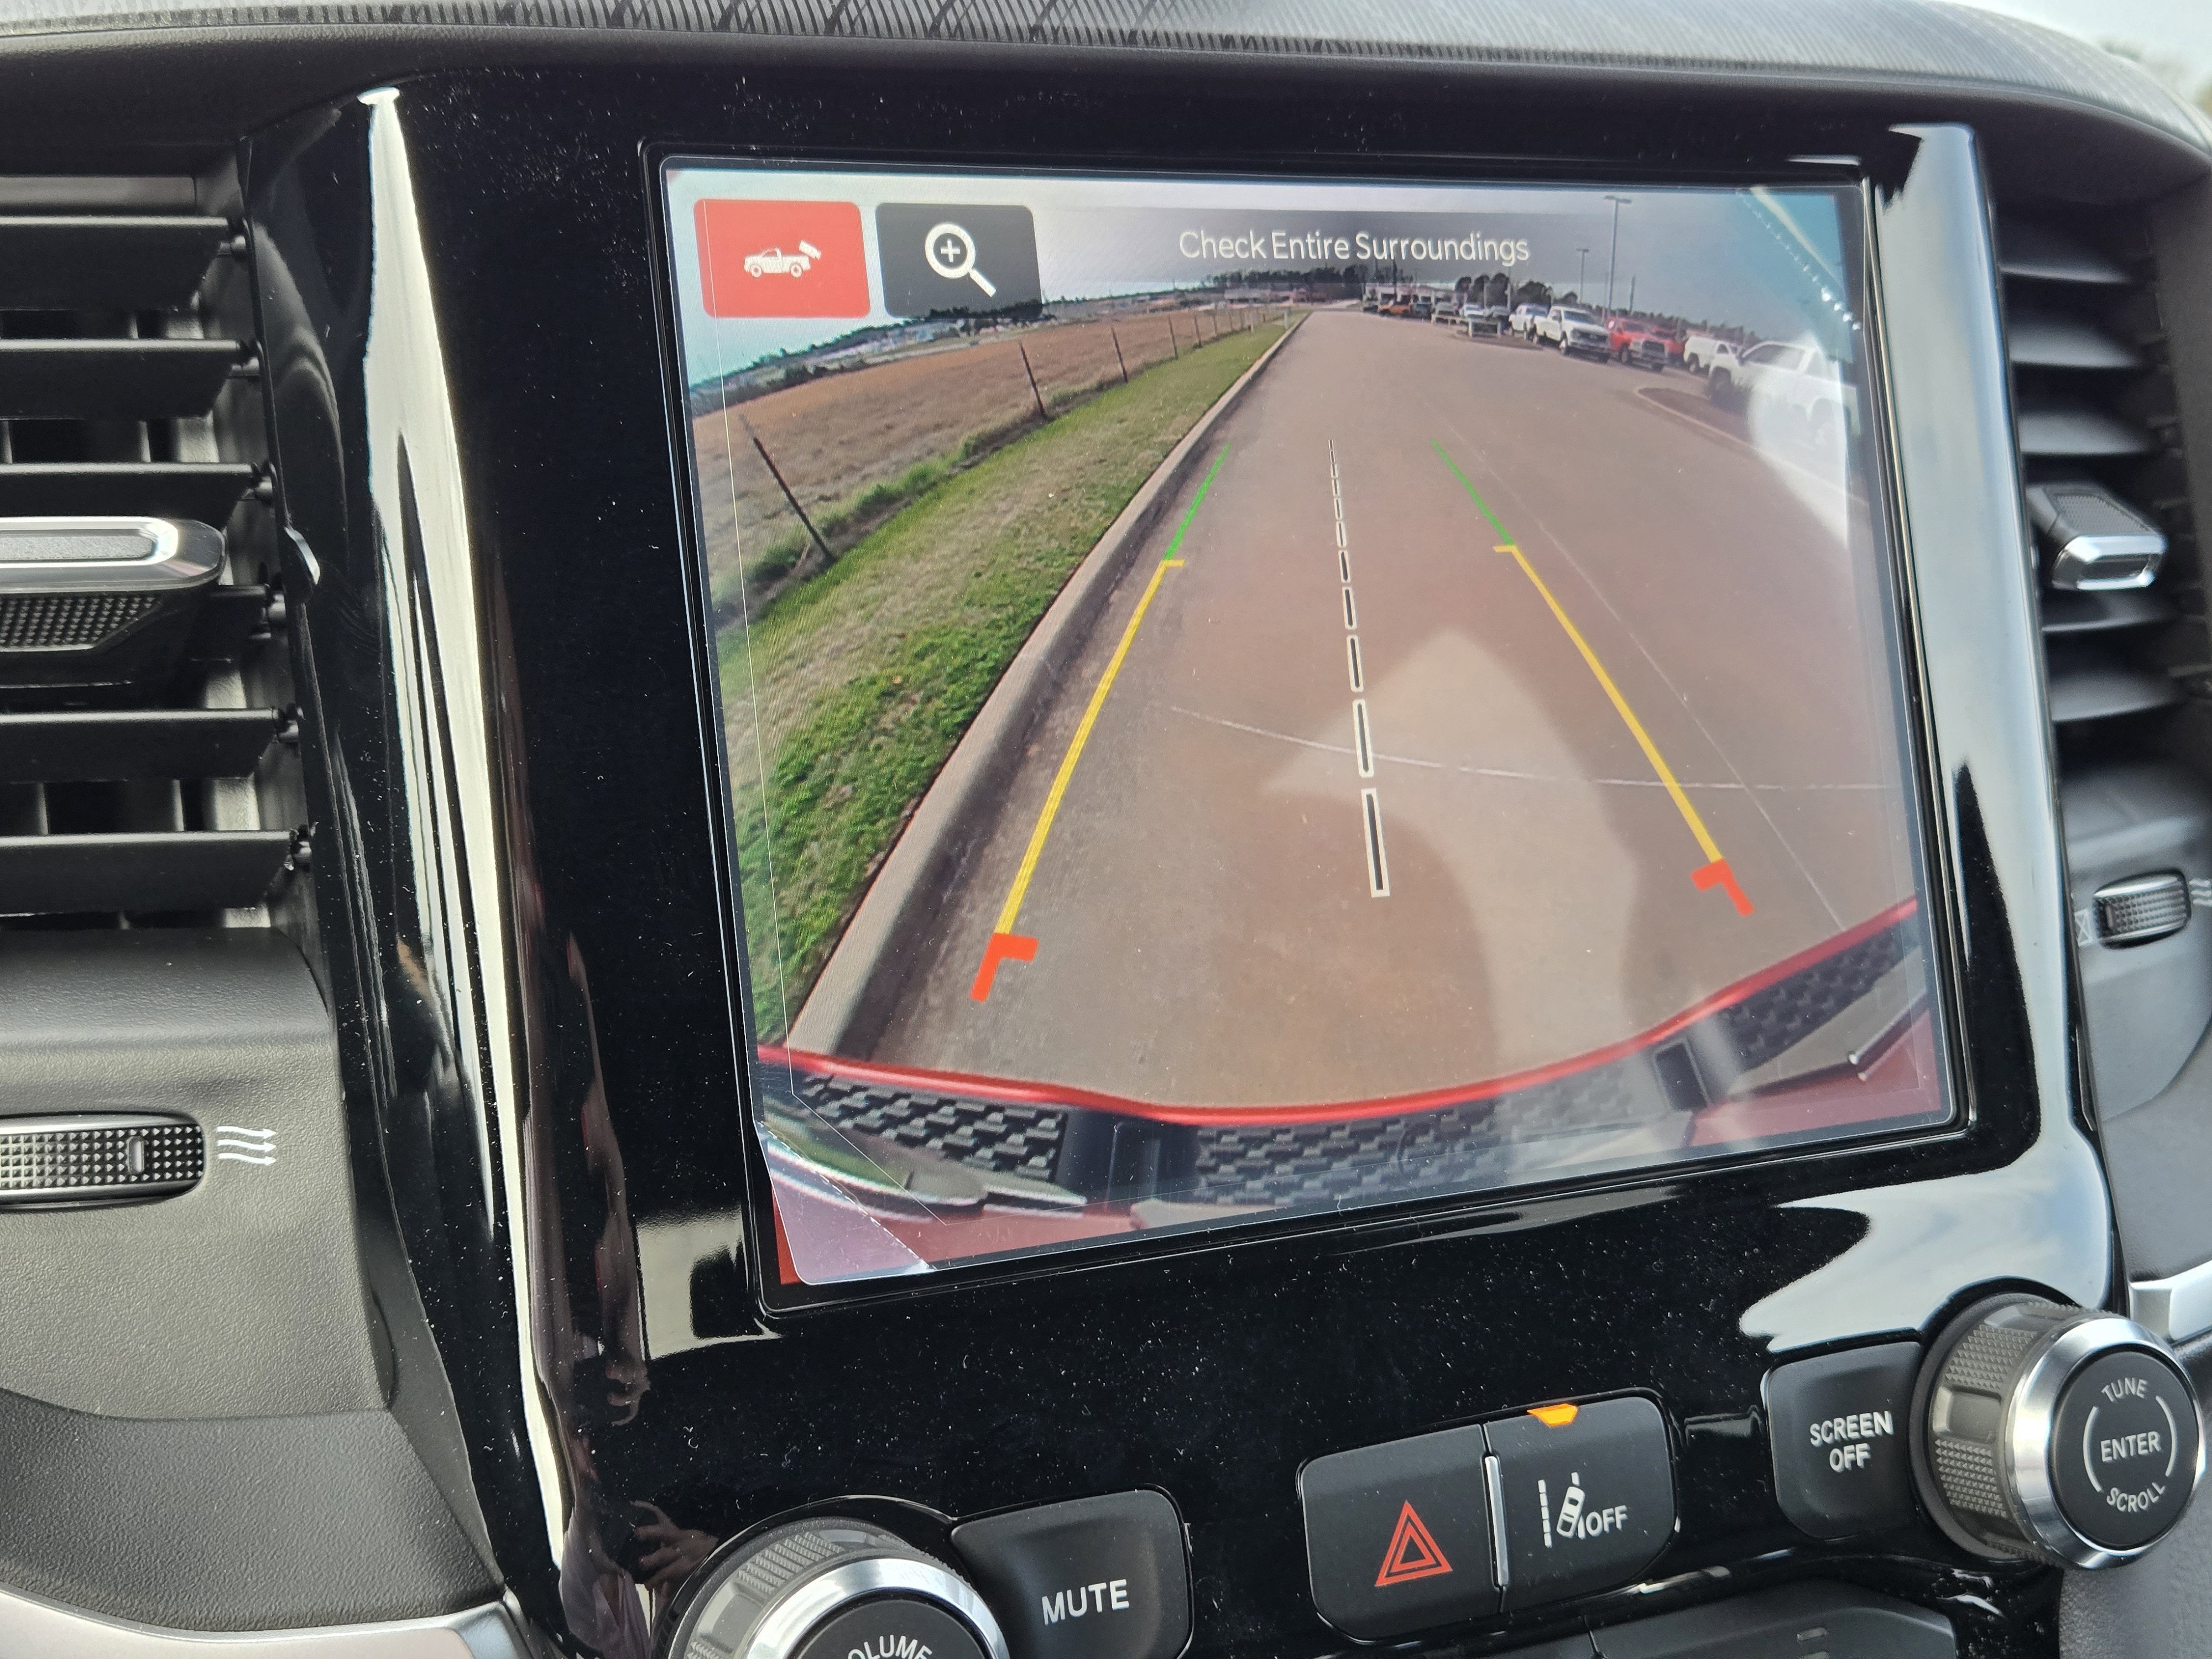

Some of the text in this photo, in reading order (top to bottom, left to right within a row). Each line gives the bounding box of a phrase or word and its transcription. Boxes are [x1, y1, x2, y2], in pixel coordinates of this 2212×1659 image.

[1179, 229, 1530, 267] Check Entire Surroundings
[2101, 1377, 2150, 1405] TUNE
[1809, 1411, 1894, 1447] SCREEN
[1829, 1442, 1871, 1473] OFF
[2100, 1431, 2161, 1464] ENTER
[2106, 1481, 2166, 1512] SCROLL
[1585, 1505, 1628, 1537] OFF
[1041, 1579, 1130, 1625] MUTE
[847, 1634, 933, 1659] OLUME
